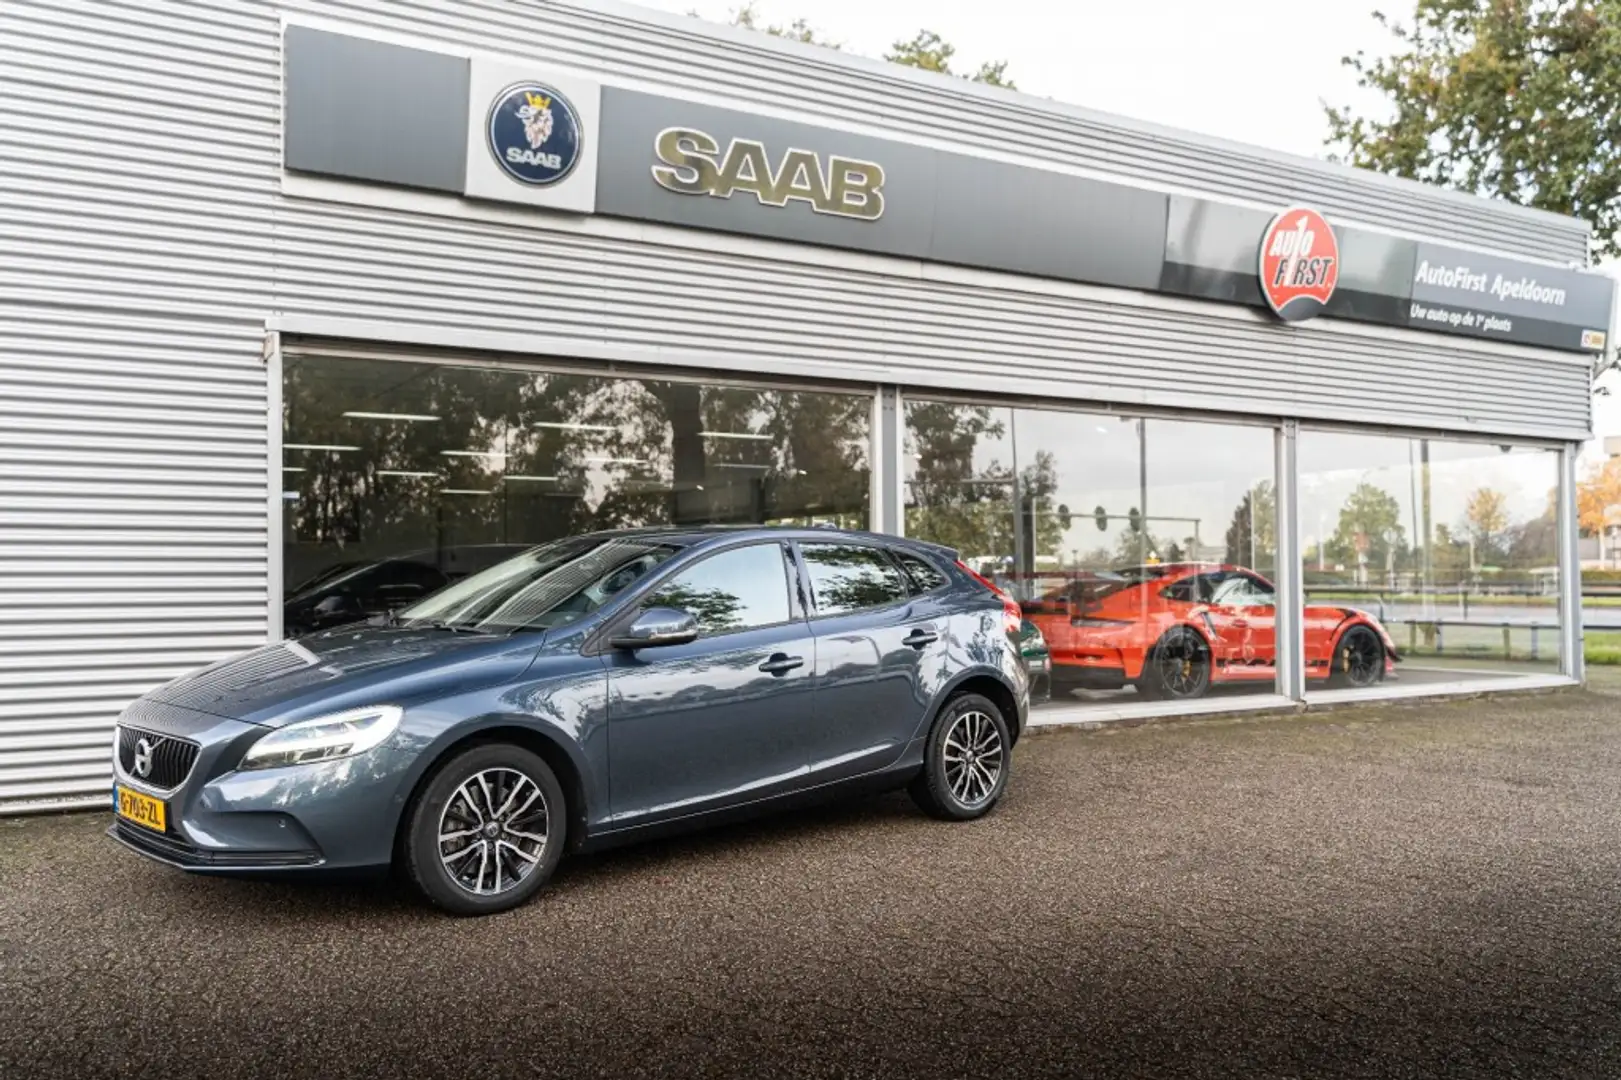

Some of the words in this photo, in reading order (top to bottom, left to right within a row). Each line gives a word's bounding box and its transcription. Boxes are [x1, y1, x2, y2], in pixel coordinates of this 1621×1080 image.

[506, 147, 561, 169] SAAB
[650, 126, 886, 221] SAAB
[1272, 256, 1336, 288] FIRST
[1415, 260, 1487, 293] AutoFirst
[1490, 273, 1566, 306] Apeldoorn
[1410, 303, 1427, 319] Uw
[1426, 309, 1449, 322] auto
[1449, 312, 1462, 327] op
[1462, 311, 1475, 326] de
[1483, 315, 1512, 332] plaats
